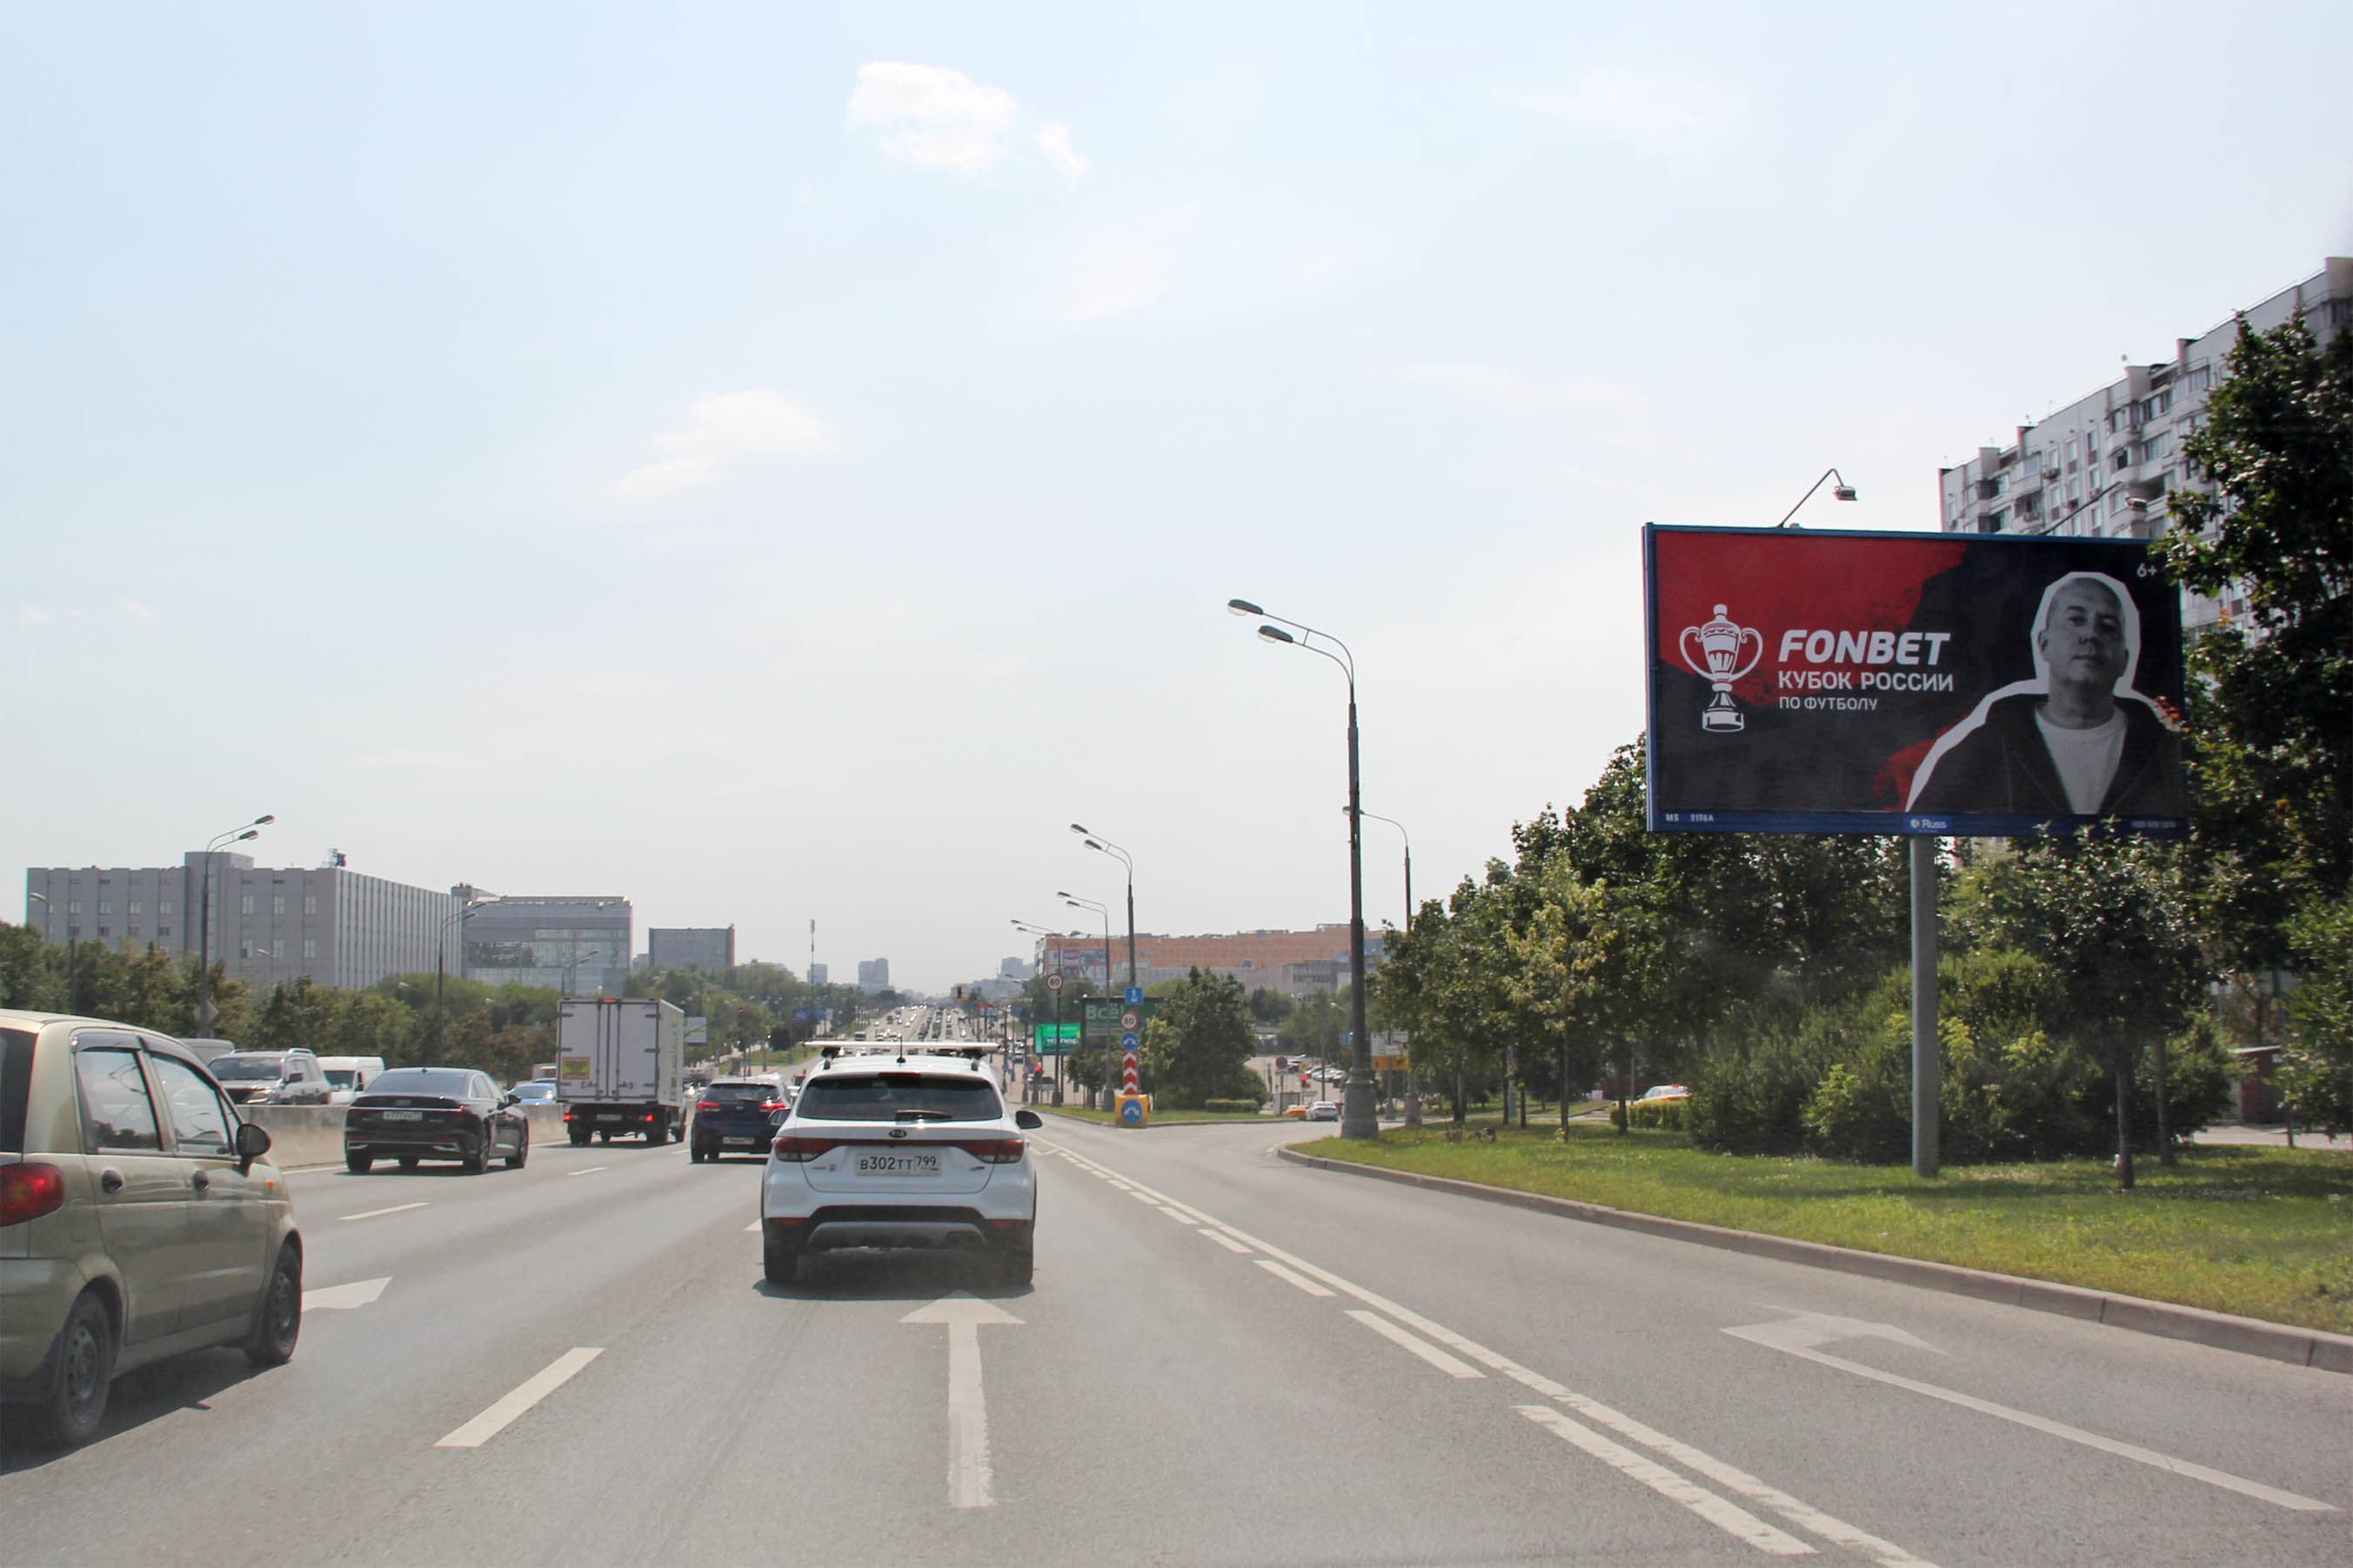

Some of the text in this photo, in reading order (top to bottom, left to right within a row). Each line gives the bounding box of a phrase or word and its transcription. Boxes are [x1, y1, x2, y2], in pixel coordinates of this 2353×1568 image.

[2136, 563, 2157, 577] 6+
[1778, 629, 1950, 665] FONBET
[1778, 671, 1954, 691] КУБОК РОССИИ
[1779, 697, 1878, 710] ПО ФУТБОЛУ
[1124, 1016, 1134, 1024] 80
